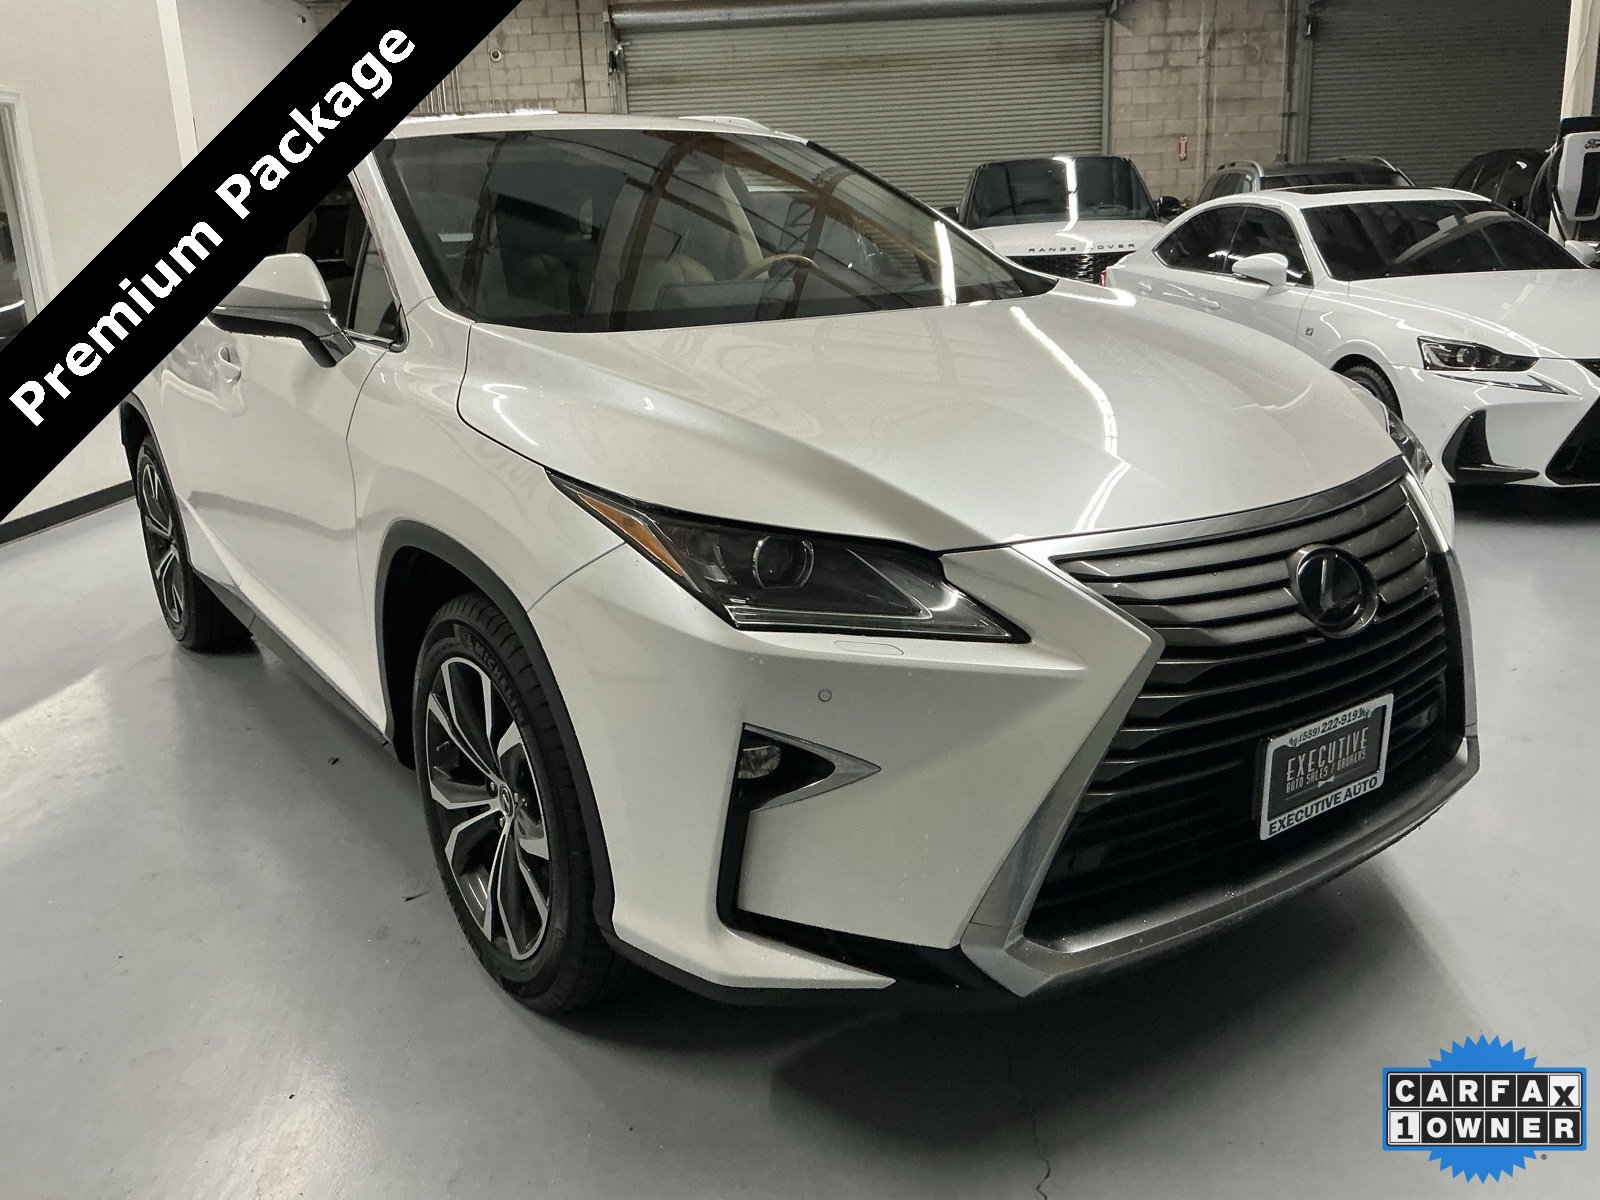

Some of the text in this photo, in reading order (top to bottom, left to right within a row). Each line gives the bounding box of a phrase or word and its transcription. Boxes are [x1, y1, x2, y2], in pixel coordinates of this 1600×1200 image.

[1584, 139, 1600, 150] For
[1087, 243, 1136, 251] OVER
[1300, 726, 1320, 742] (559)
[1286, 727, 1369, 781] EXECUTIVE
[1286, 778, 1304, 794] AUTO
[1306, 766, 1328, 785] SALES
[1269, 776, 1378, 836] EXECUTIVE AUTO
